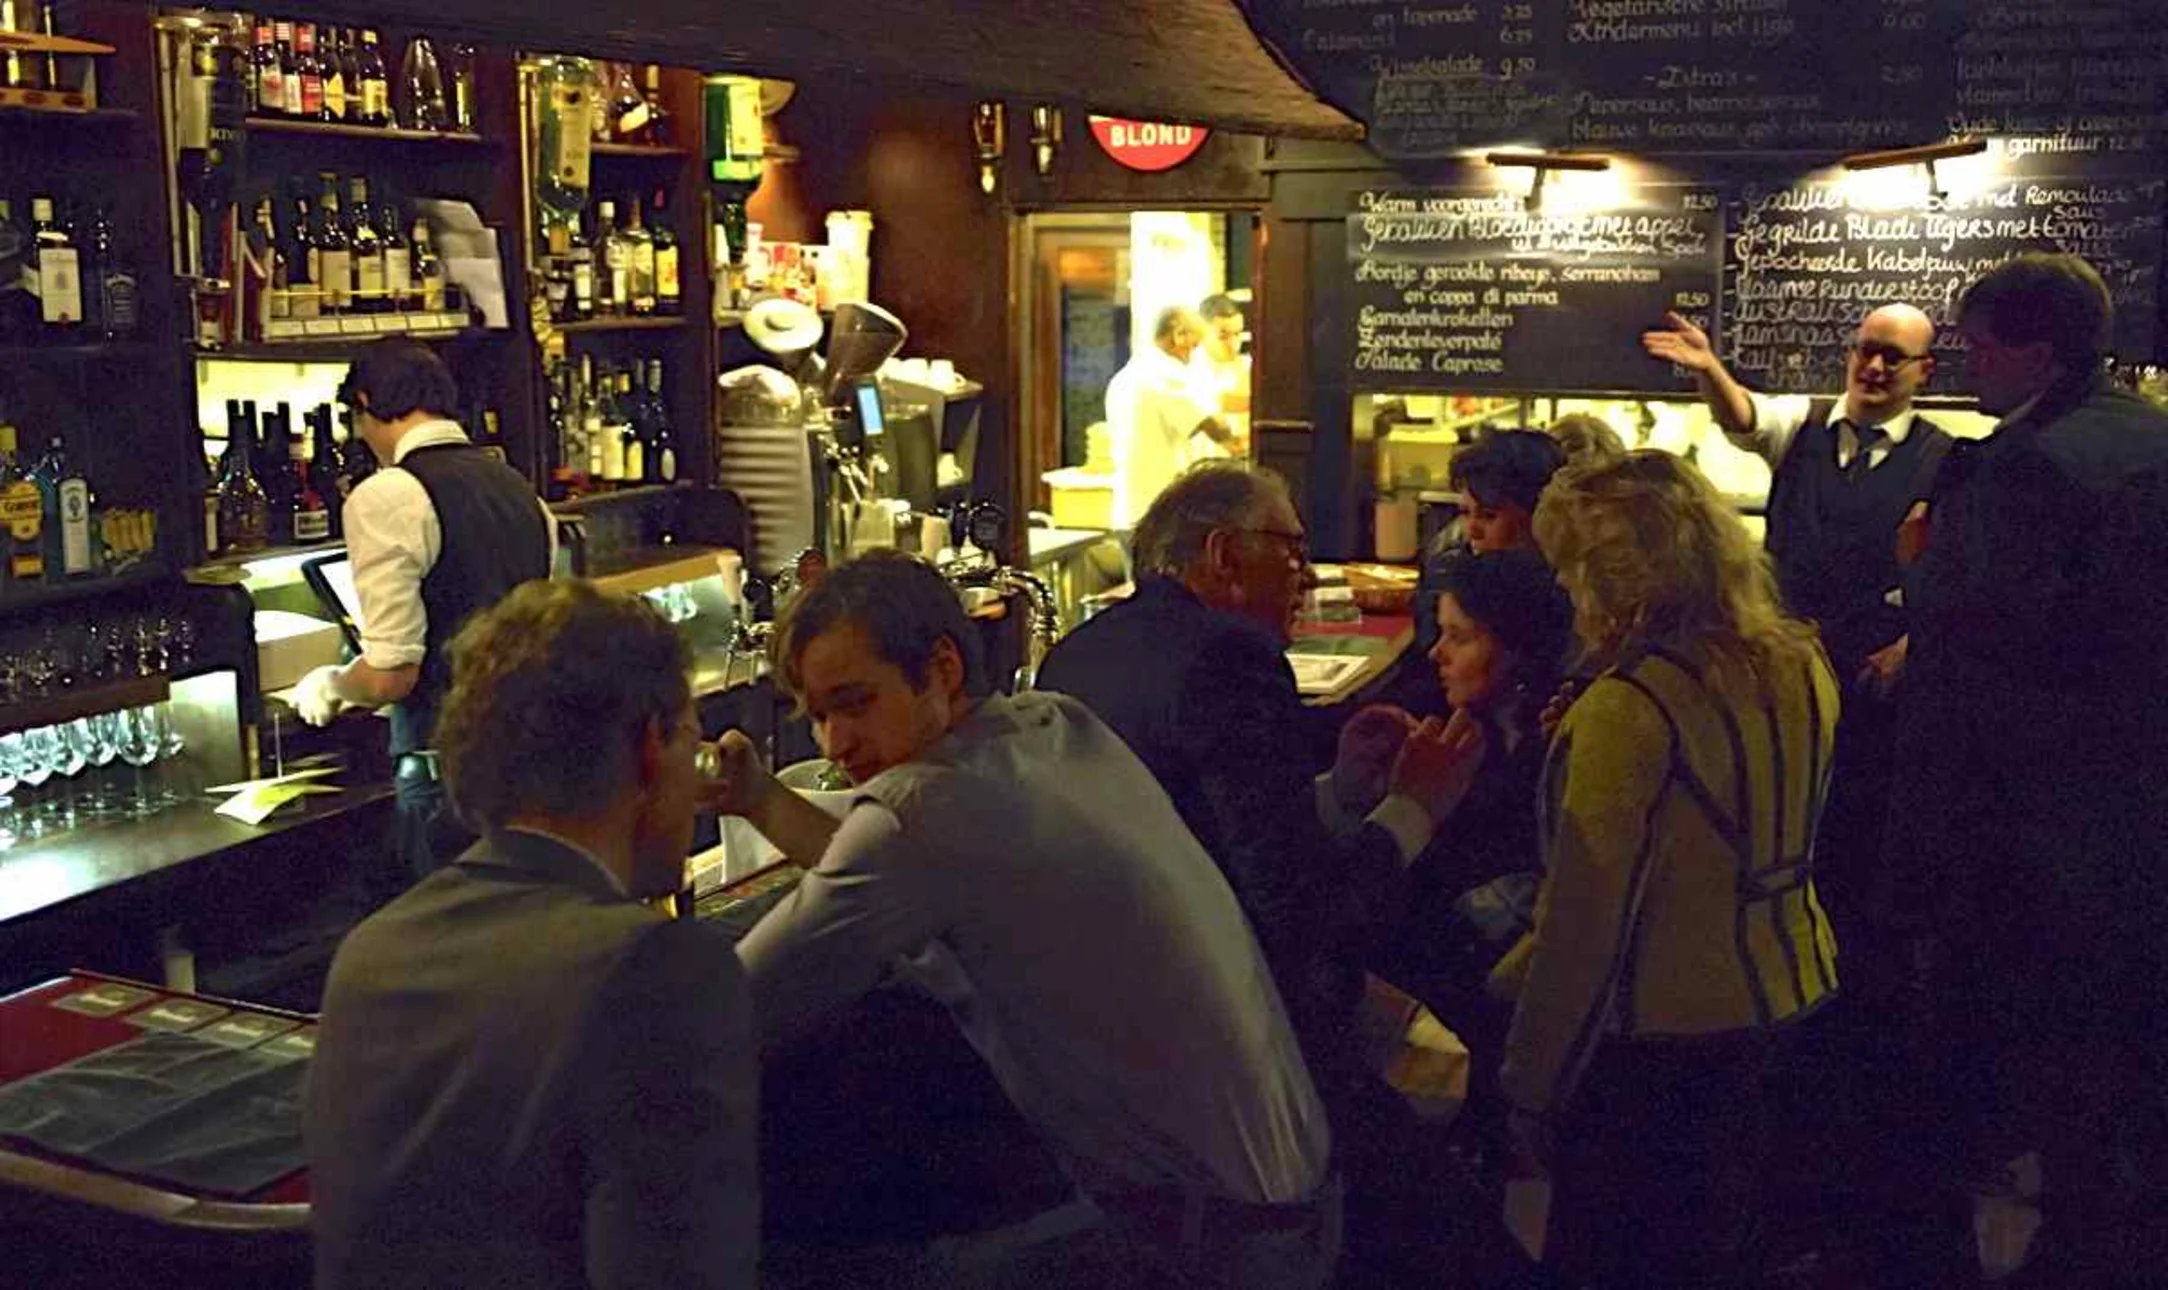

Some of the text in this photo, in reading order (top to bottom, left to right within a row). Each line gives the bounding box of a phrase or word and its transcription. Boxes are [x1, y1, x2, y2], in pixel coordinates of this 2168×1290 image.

[1111, 122, 1192, 147] BLOND
[2008, 134, 2101, 158] garnituur
[1403, 289, 1425, 304] en
[1505, 290, 1559, 308] parma
